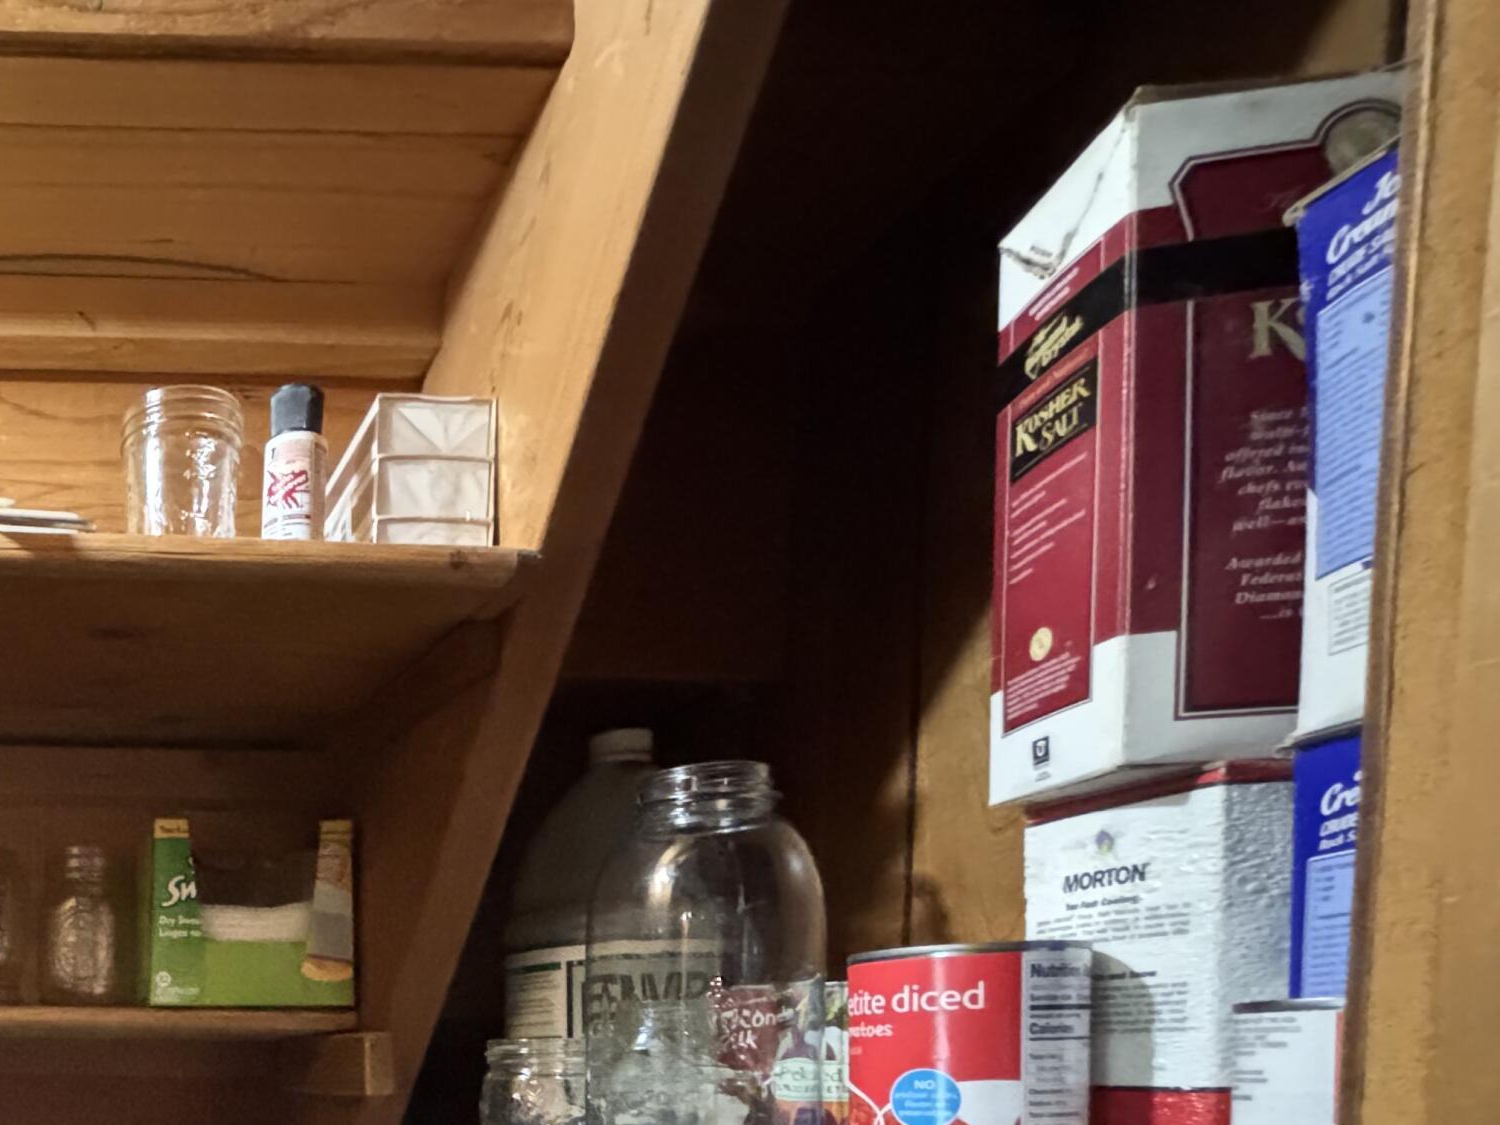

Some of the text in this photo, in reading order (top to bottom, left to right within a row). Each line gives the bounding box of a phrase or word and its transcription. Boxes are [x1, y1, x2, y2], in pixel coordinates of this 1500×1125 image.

[1014, 378, 1091, 458] KOSHER
[1039, 403, 1083, 449] SALT
[1062, 862, 1152, 895] MORTON
[891, 980, 985, 1013] diced
[913, 1079, 935, 1090] NO
